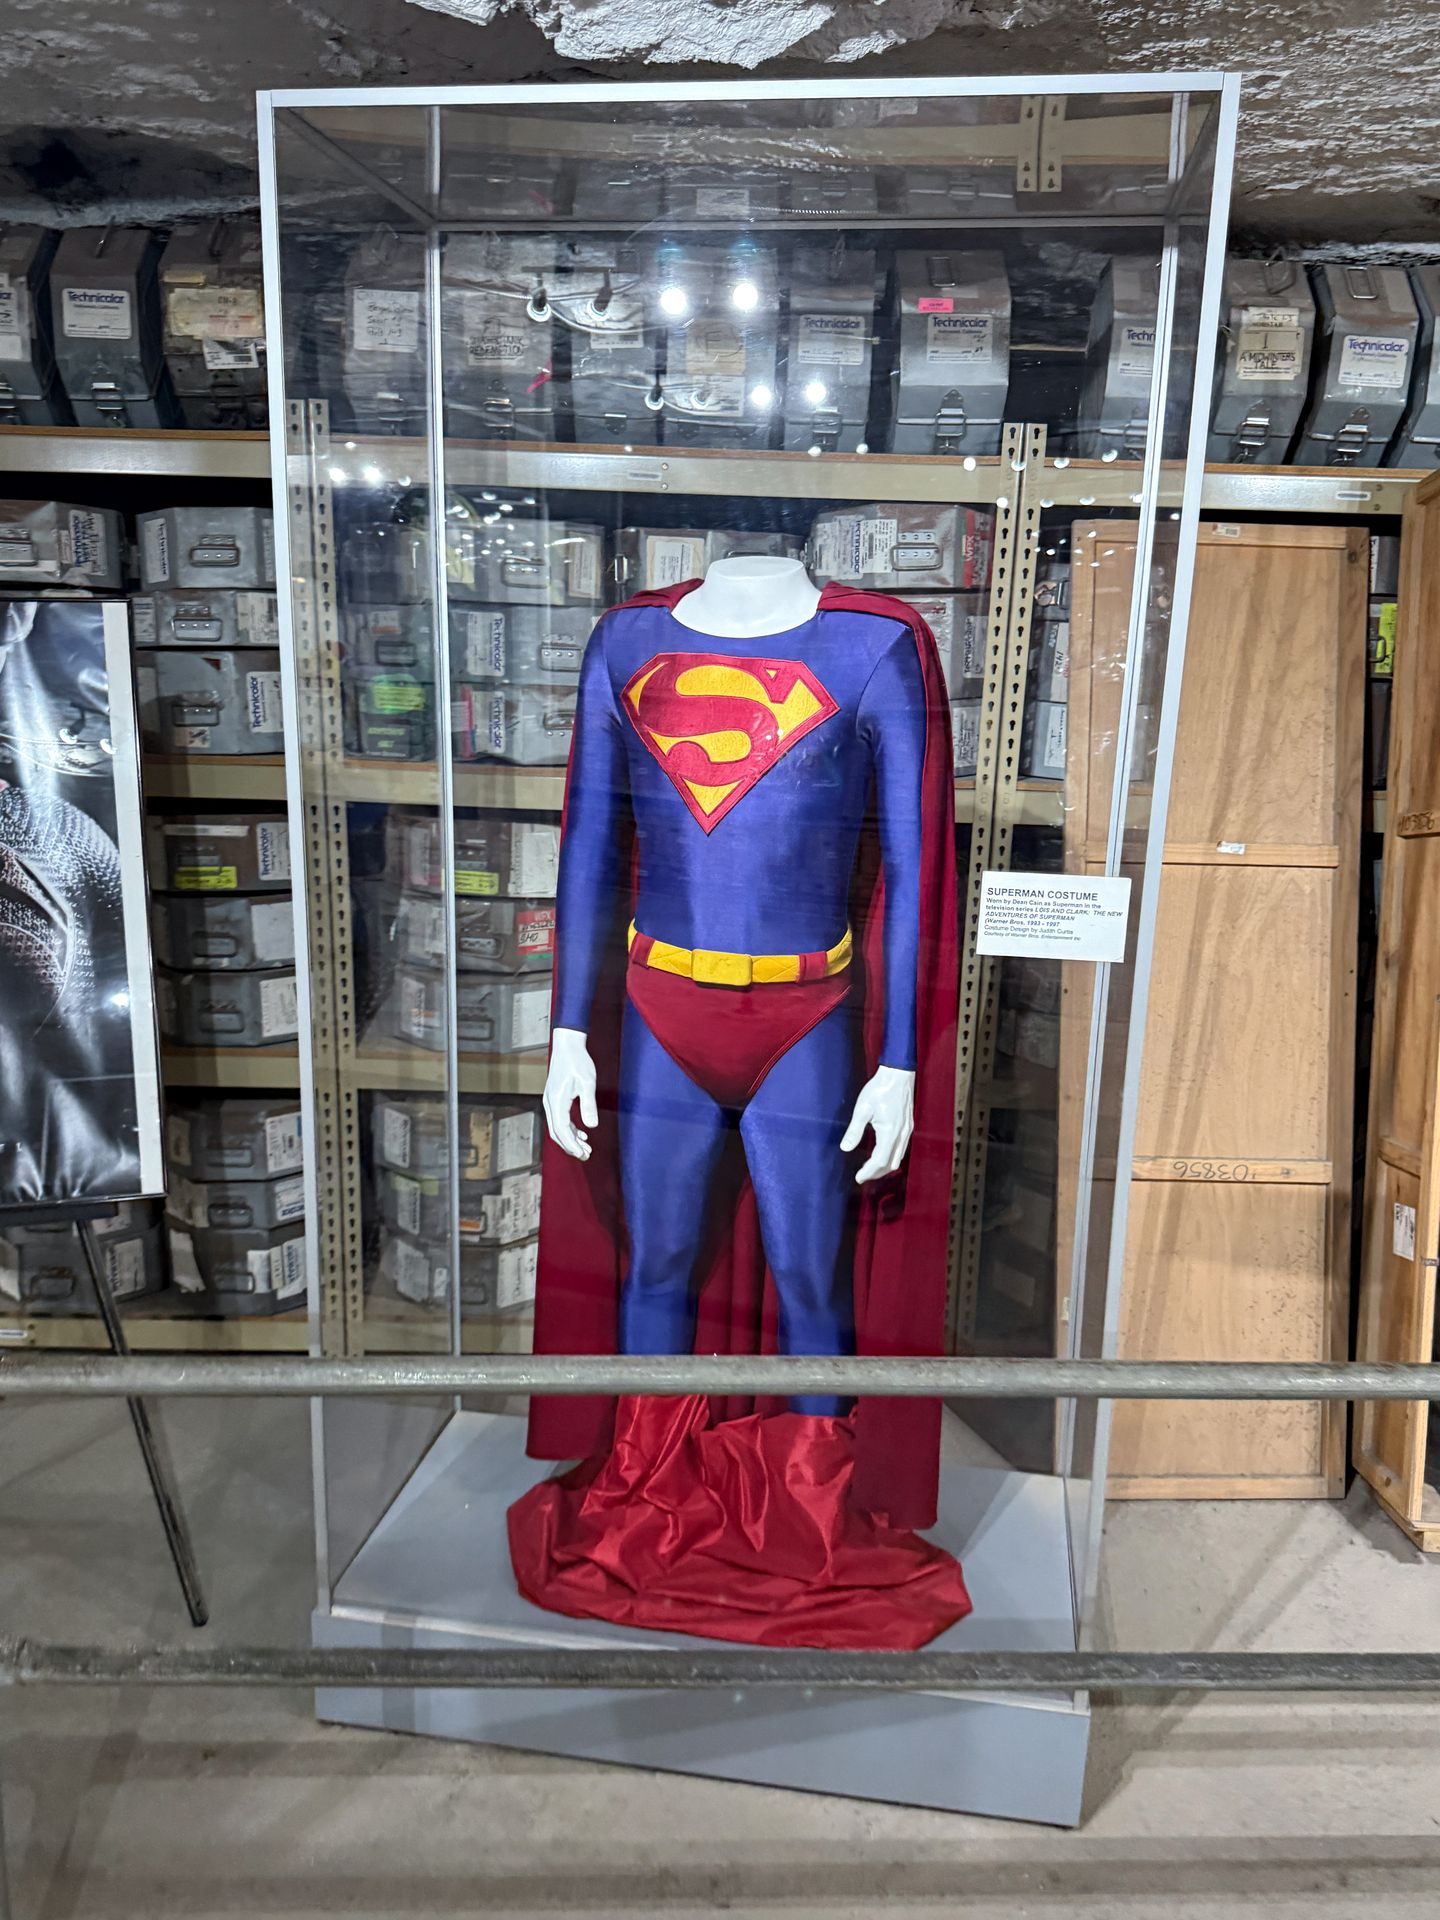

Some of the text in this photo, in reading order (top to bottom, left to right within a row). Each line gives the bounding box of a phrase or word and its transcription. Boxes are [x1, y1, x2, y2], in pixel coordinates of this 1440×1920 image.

[67, 290, 125, 304] Technicolor
[803, 316, 861, 329] Technicolor
[932, 316, 989, 328] Technicolor
[1348, 338, 1405, 352] Technicolor
[493, 617, 503, 672] Technicolor
[250, 676, 261, 729] Technicolor
[987, 887, 1099, 901] SUPERMAN COSTUME
[985, 911, 1028, 919] ADVENTURES
